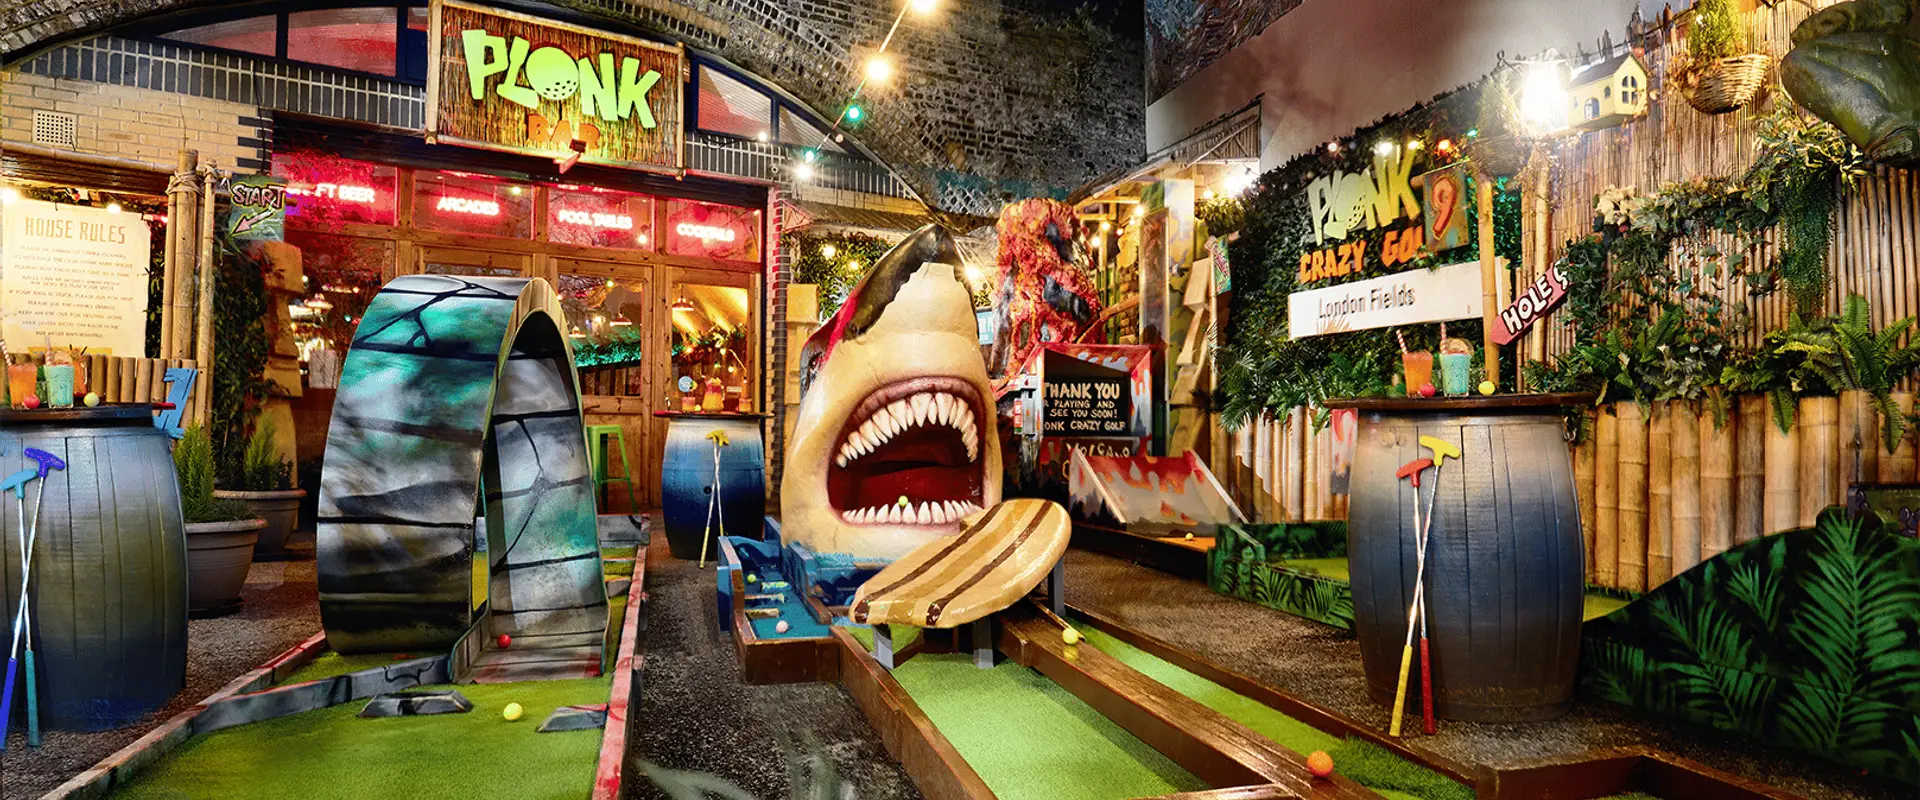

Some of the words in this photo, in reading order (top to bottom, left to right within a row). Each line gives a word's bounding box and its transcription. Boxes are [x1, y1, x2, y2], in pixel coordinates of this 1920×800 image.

[462, 29, 661, 128] PLONK
[528, 114, 600, 149] BAR
[231, 183, 285, 211] START
[338, 185, 376, 203] BEER
[436, 196, 500, 216] ARCADES
[1307, 139, 1421, 246] PLONK
[558, 209, 593, 226] POOL
[592, 212, 633, 230] TABLES
[1432, 176, 1458, 241] 9
[25, 217, 73, 239] HOUSE
[79, 221, 126, 245] RULES
[1300, 240, 1367, 285] CRAZY
[1381, 225, 1428, 267] GOL
[1319, 294, 1366, 318] London
[1369, 282, 1416, 311] Fields
[1502, 276, 1552, 334] HOLE
[1044, 382, 1092, 399] THANK
[1094, 382, 1120, 400] YOU
[1054, 400, 1091, 408] PLAYING
[1096, 401, 1115, 409] AND
[1043, 421, 1065, 431] ONK
[1069, 420, 1101, 431] CRAZY
[1104, 421, 1126, 432] GOLF
[1049, 409, 1069, 417] SEE
[1071, 409, 1089, 418] YOU
[1090, 408, 1118, 418] SOON!
